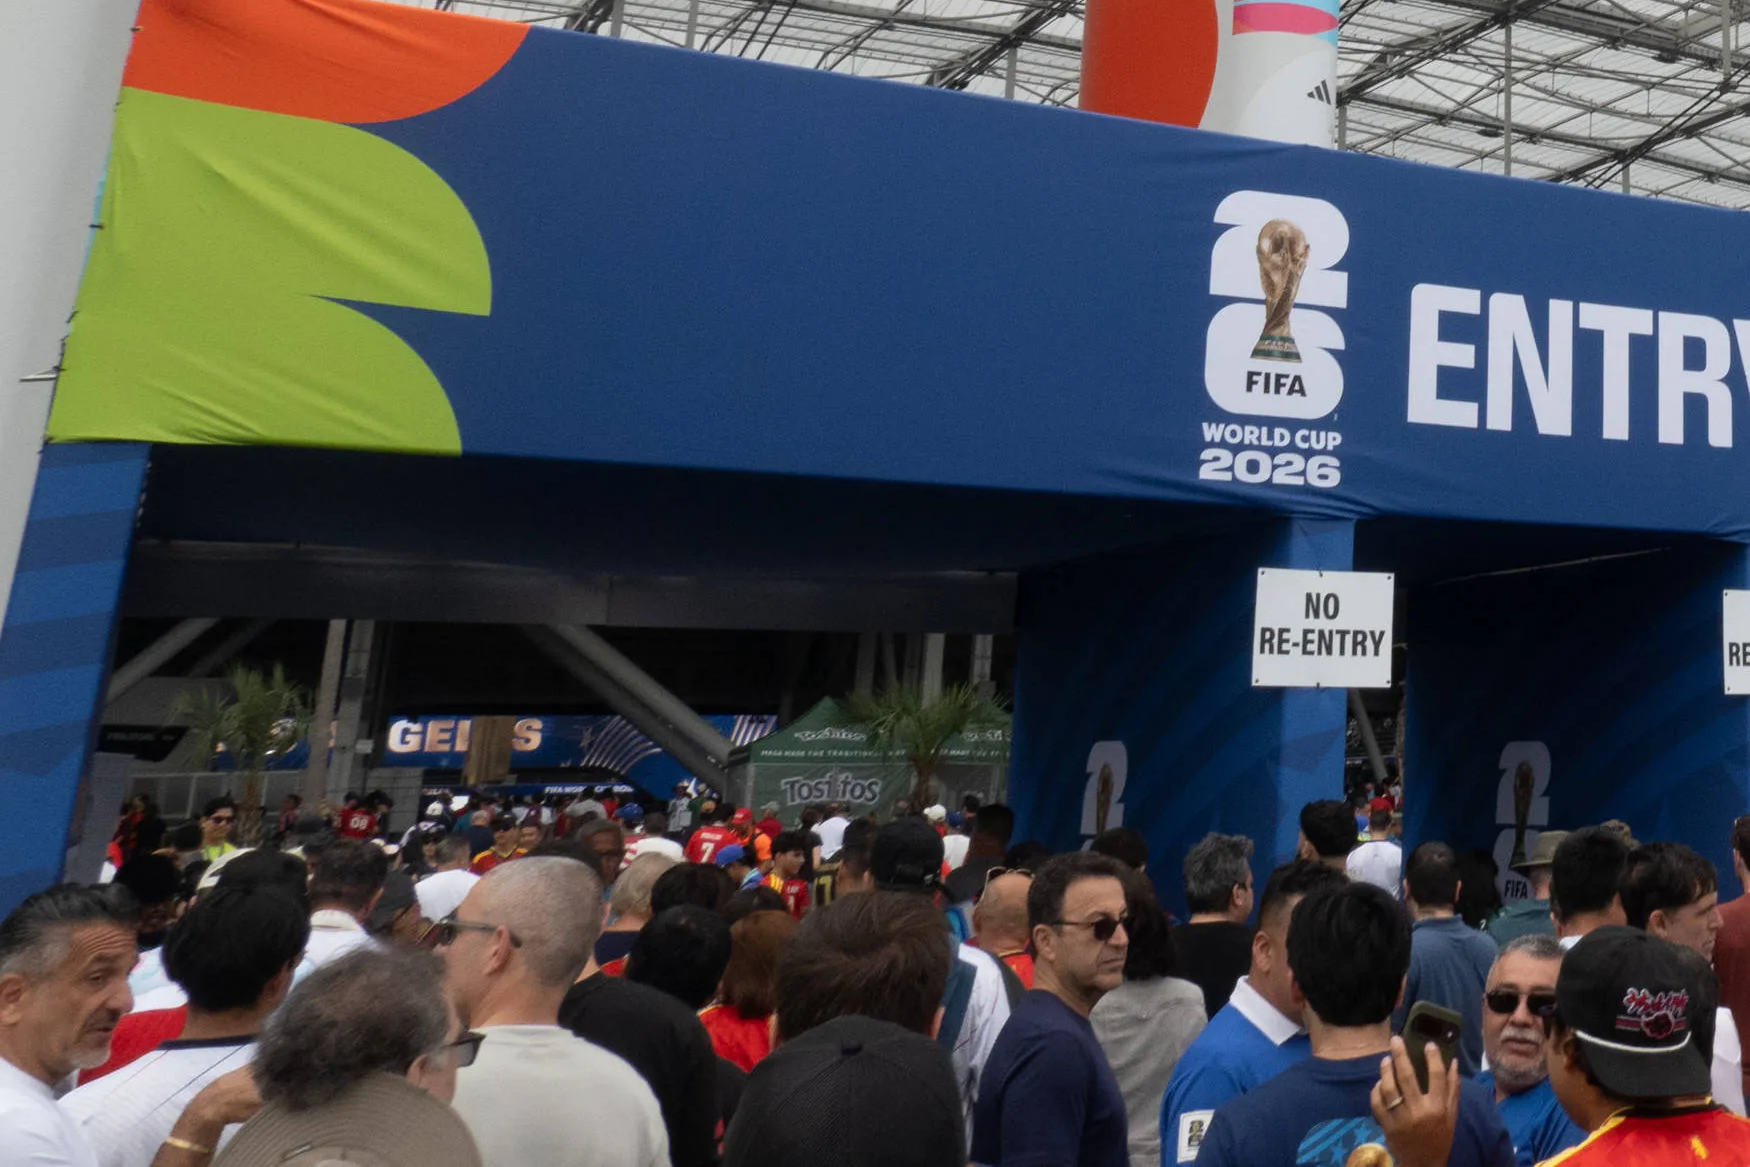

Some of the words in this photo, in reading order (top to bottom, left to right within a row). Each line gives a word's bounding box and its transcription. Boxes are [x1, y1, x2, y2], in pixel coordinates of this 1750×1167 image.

[1246, 371, 1307, 397] FIFA
[1202, 422, 1291, 447] WORLD
[1295, 429, 1342, 451] CUP
[1199, 448, 1341, 488] 2026
[1304, 592, 1340, 621] NO
[1259, 627, 1386, 657] RE-ENTRY
[387, 717, 543, 753] GES
[1504, 879, 1528, 899] FIFA
